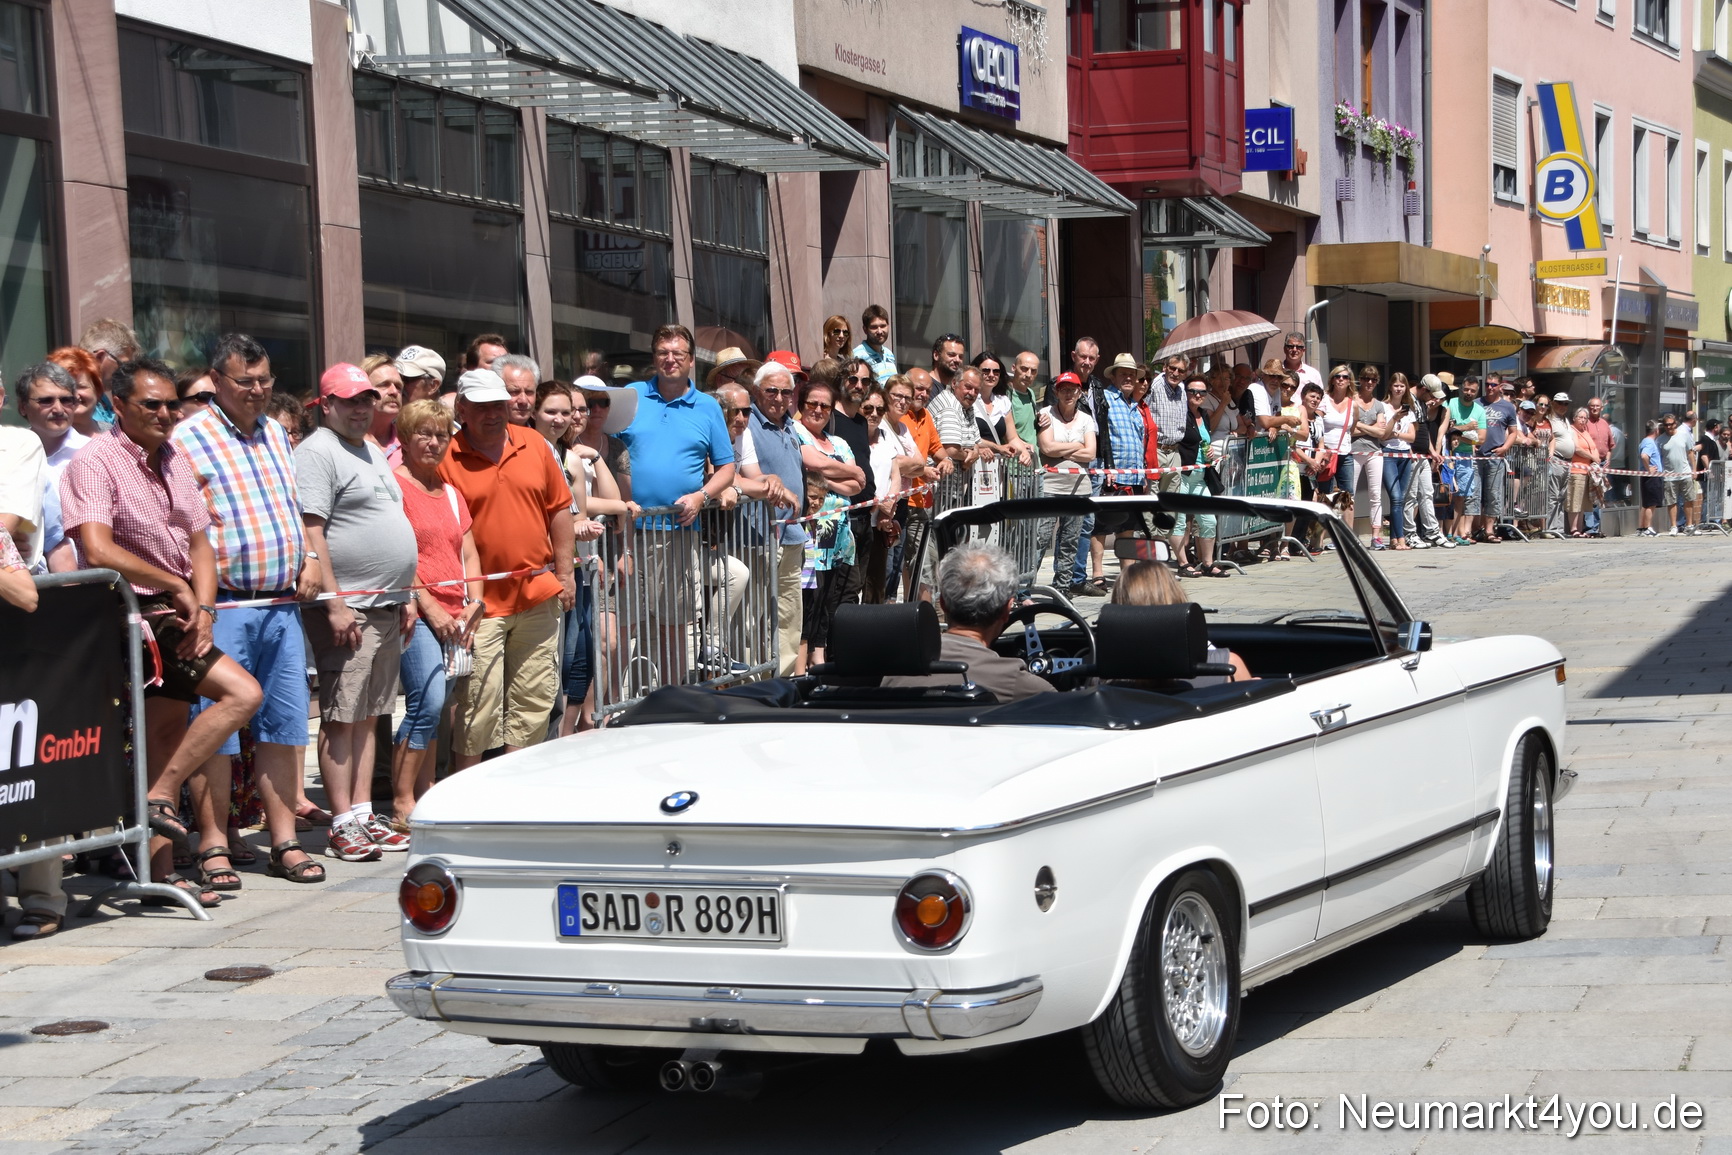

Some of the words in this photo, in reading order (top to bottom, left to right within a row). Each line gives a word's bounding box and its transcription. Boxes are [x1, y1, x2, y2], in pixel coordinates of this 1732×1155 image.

[834, 42, 881, 73] Klostergasse
[881, 58, 887, 76] 2
[970, 36, 1020, 93] CECIL
[1244, 127, 1285, 146] ECIL
[1543, 169, 1575, 203] B
[1539, 262, 1594, 274] KLOSTERGASSE
[1596, 262, 1601, 270] 4
[1444, 340, 1457, 348] DIE
[1459, 337, 1523, 348] GOLDSCHMIEDE
[1258, 472, 1270, 485] Action
[40, 726, 101, 764] GmbH
[565, 915, 575, 928] D
[581, 892, 642, 931] SAD
[665, 894, 686, 932] R
[694, 894, 778, 934] 889H
